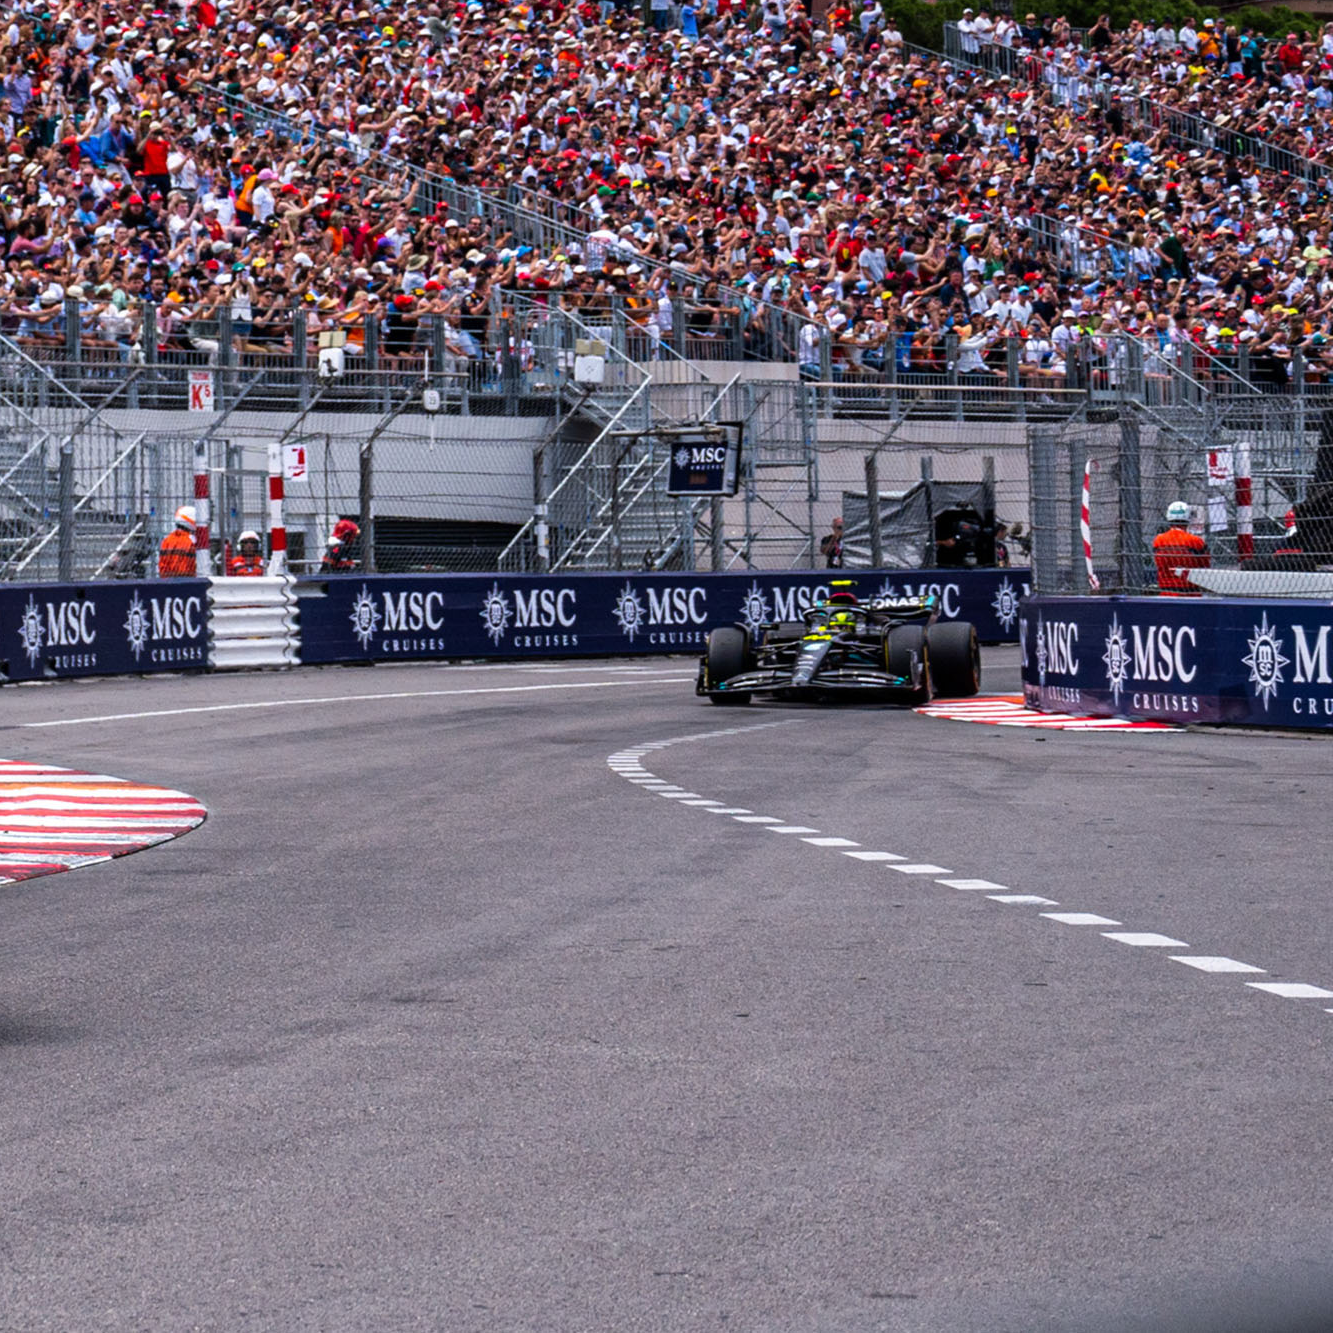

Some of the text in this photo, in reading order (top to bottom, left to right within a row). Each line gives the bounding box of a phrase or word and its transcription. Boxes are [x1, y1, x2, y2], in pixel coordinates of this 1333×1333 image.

[692, 447, 725, 463] MSC
[383, 592, 444, 631] MSC
[514, 589, 577, 627] MSC
[646, 587, 708, 624] MSC
[874, 596, 920, 609] ONAS
[46, 601, 96, 646] MSC
[151, 597, 201, 640] MSC
[383, 639, 445, 652] CRUISES
[515, 634, 578, 647] CRUISES
[1046, 622, 1079, 676] MSC
[1133, 625, 1196, 683] MSC
[49, 654, 97, 669] RUISES
[152, 648, 202, 662] CRUISES
[1134, 693, 1199, 713] CRUISES
